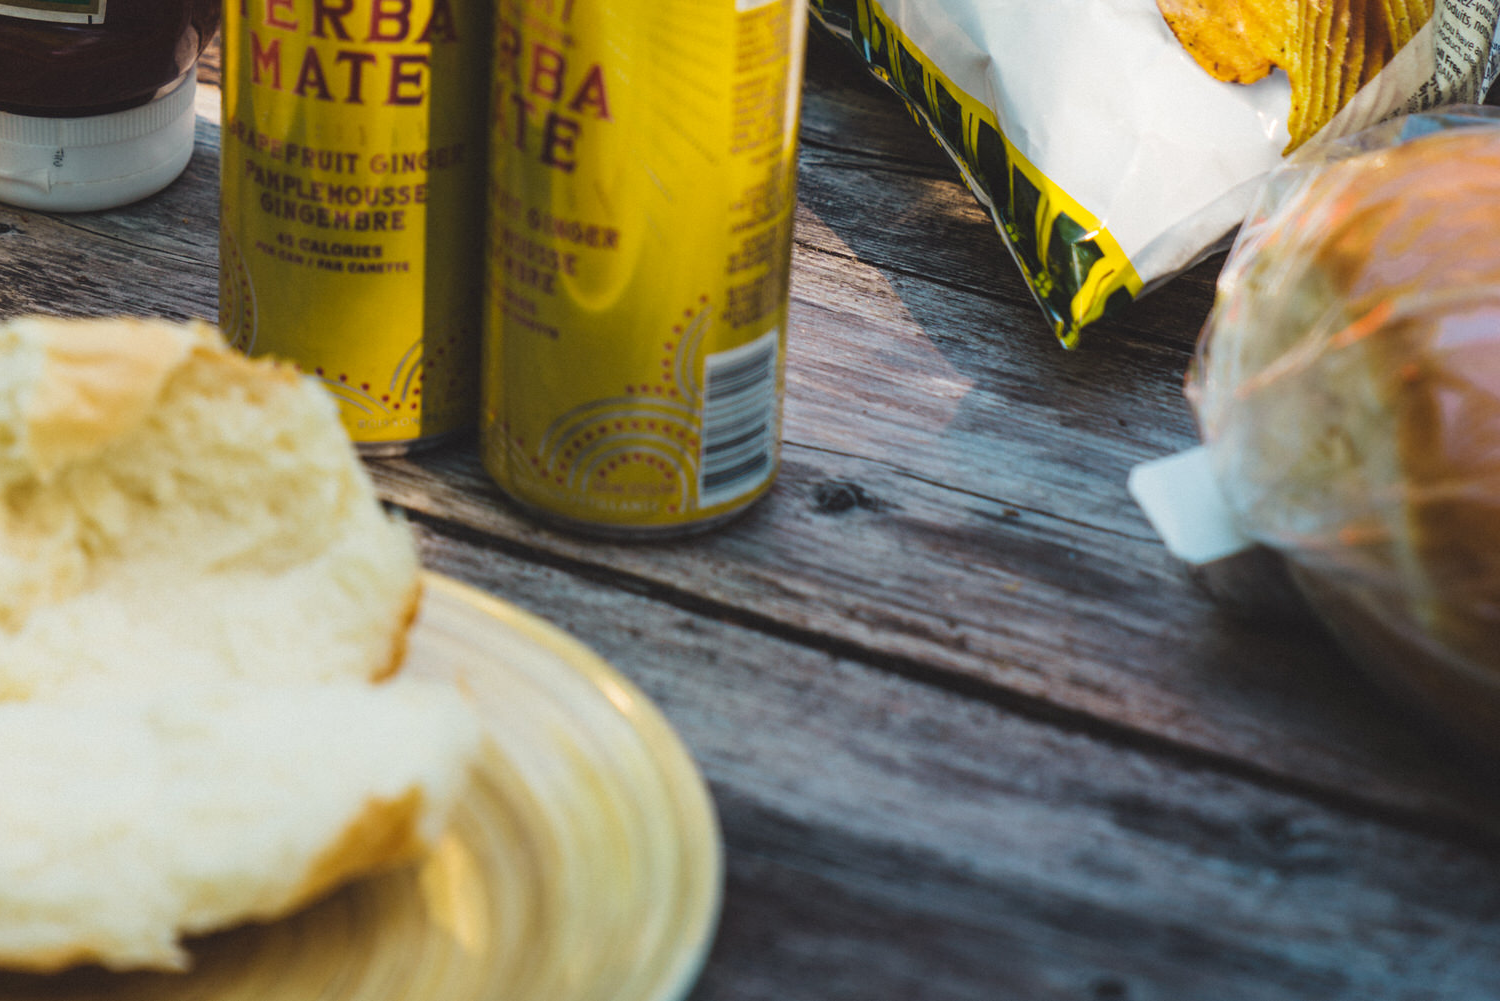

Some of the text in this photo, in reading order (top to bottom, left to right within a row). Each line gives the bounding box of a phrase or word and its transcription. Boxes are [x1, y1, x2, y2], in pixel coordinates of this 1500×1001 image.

[1456, 30, 1474, 51] have
[250, 29, 430, 106] MATE
[499, 19, 615, 124] RBA
[500, 88, 582, 176] TE
[245, 159, 429, 207] PAMPLEMOUSSE
[260, 192, 406, 232] GINGEMBRE
[299, 237, 383, 259] CALORIES
